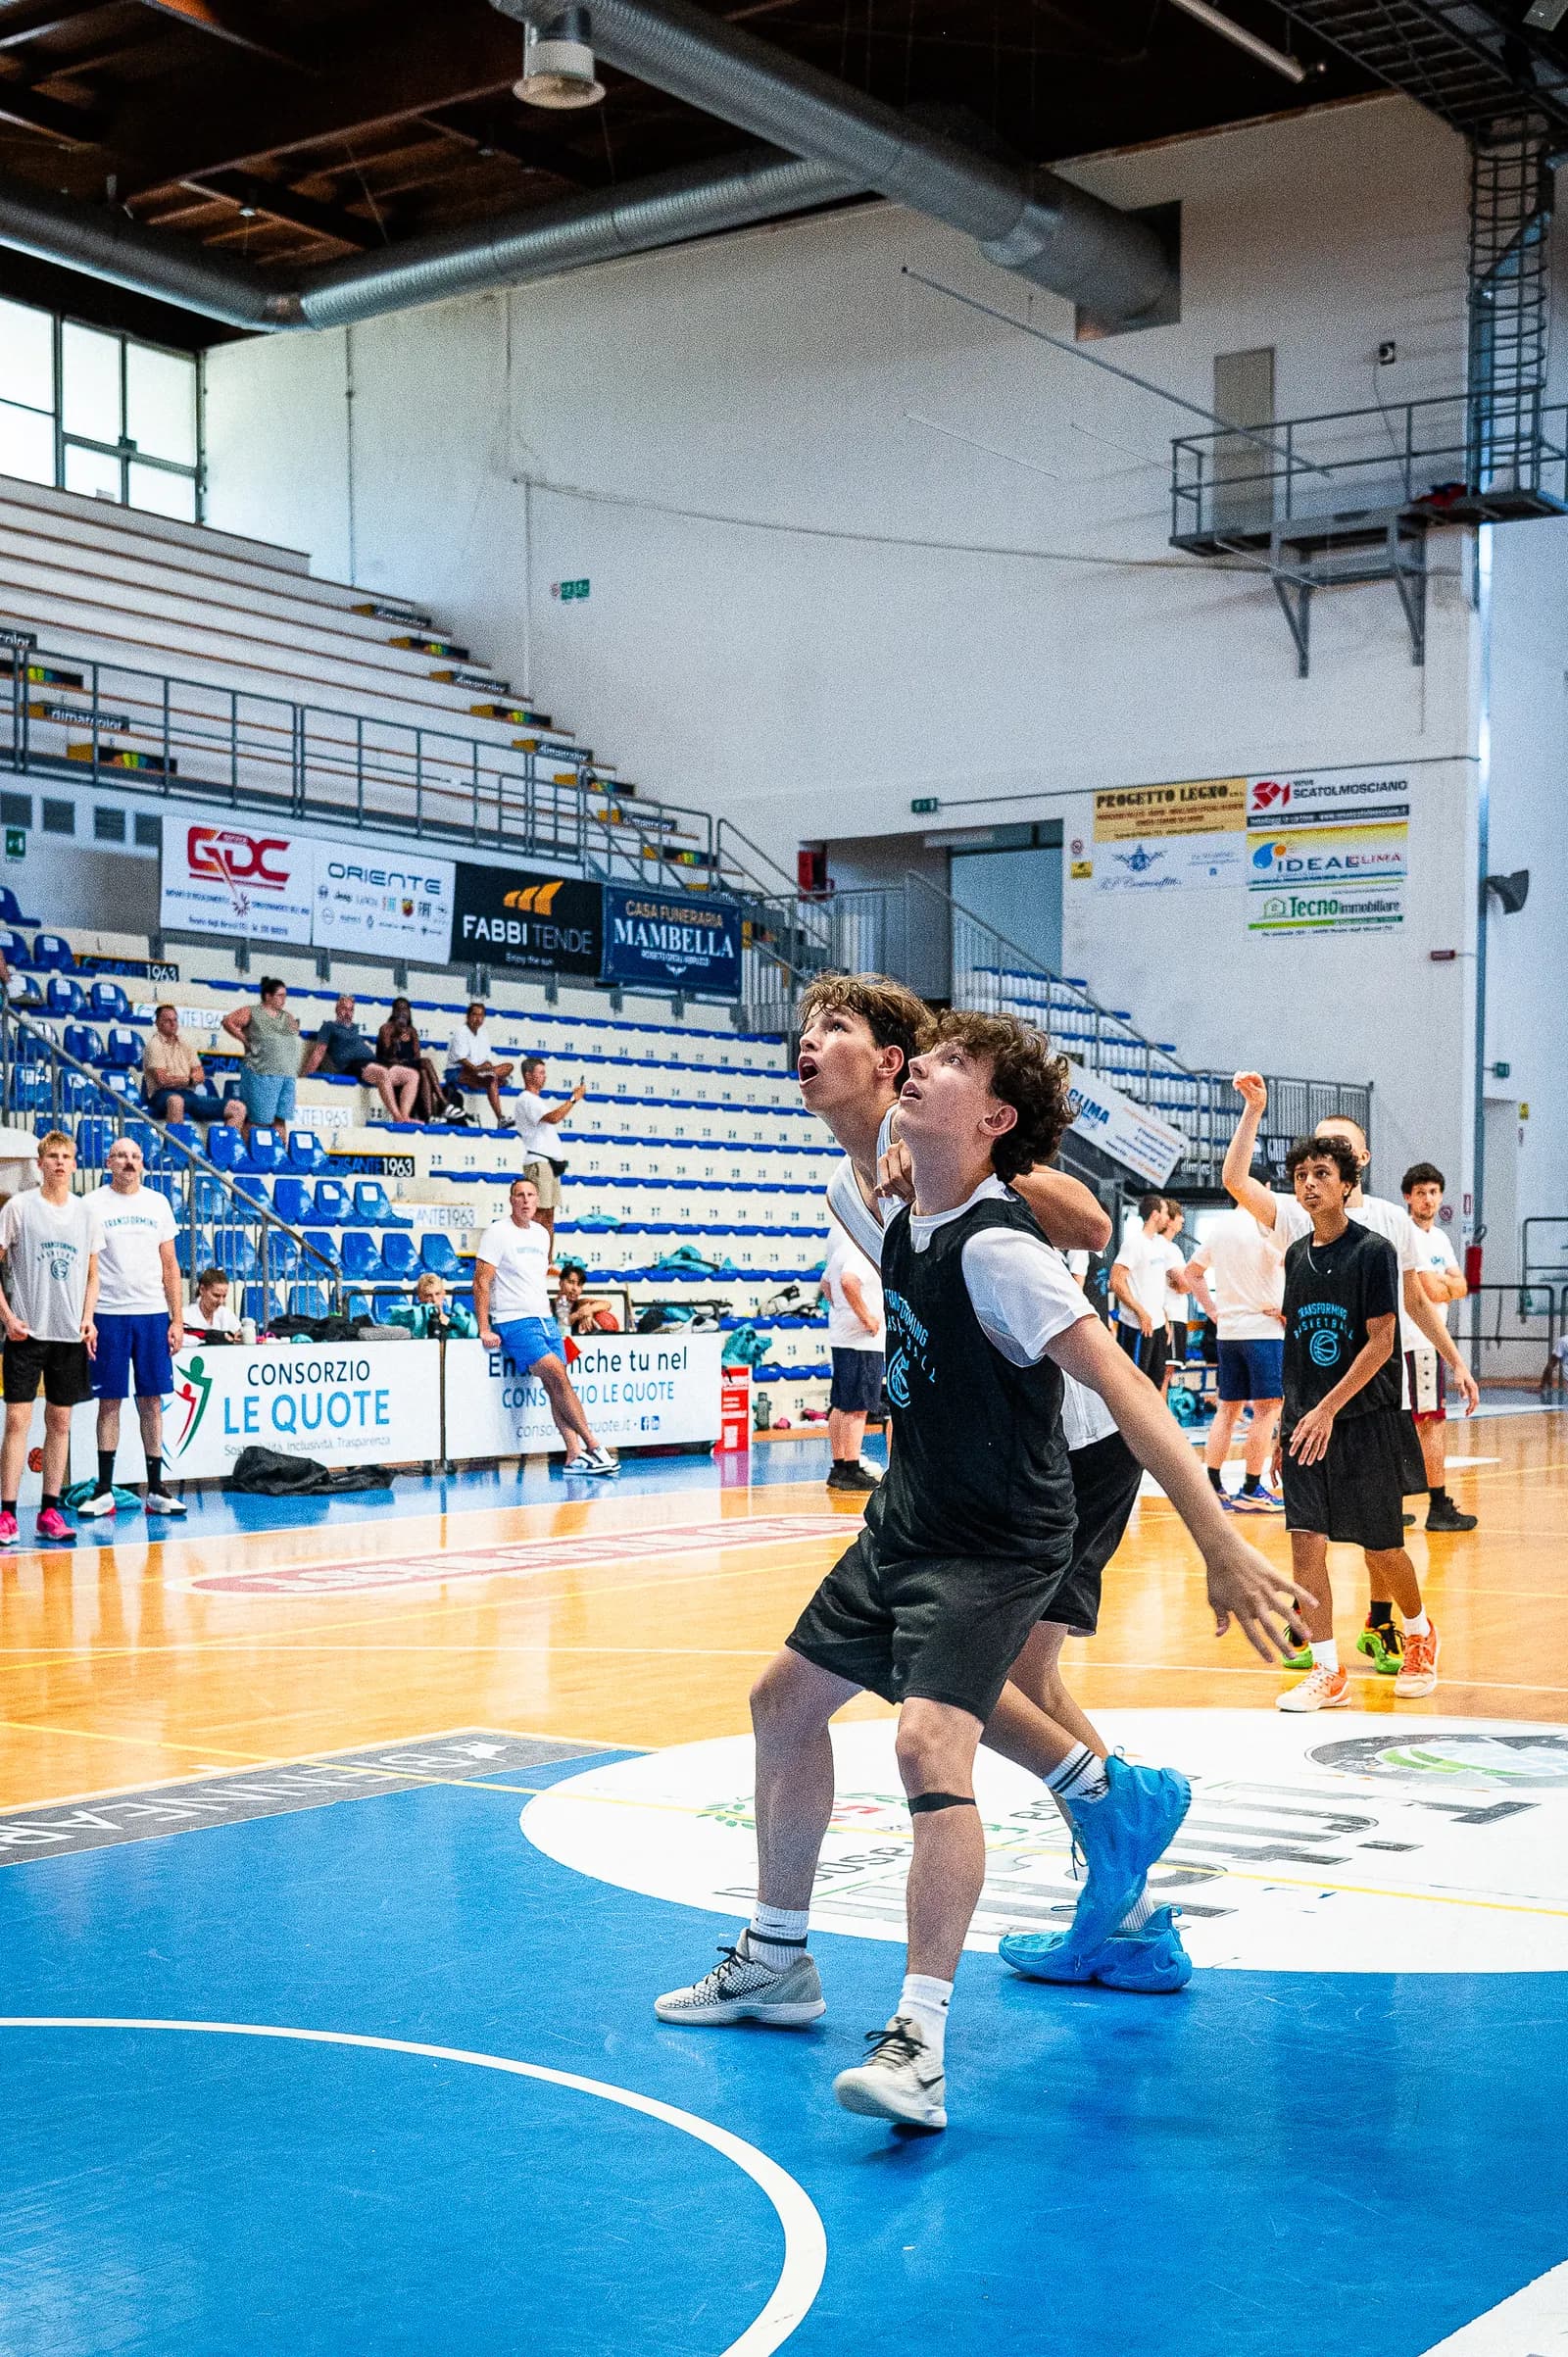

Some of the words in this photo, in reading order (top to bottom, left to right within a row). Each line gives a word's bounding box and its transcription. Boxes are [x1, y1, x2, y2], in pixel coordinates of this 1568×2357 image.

[1097, 789, 1175, 809] PROGETTO
[1180, 785, 1228, 803] LEGNO
[1293, 780, 1408, 800] SCATOLMOSCIANO
[187, 826, 291, 882] GDC
[327, 862, 442, 896] ORIENTE
[625, 900, 658, 921] CASA
[660, 904, 724, 929] FUNERARIA
[463, 914, 527, 946] FABBI
[532, 923, 593, 955] TENDE
[613, 918, 735, 958] MAMBELLA
[146, 964, 177, 981] 1963
[382, 1156, 413, 1177] 1963
[446, 1208, 474, 1229] 1963
[629, 1350, 649, 1371] tu
[658, 1346, 688, 1370] nel
[247, 1360, 370, 1386] CONSORZIO
[603, 1385, 619, 1403] LE
[623, 1381, 674, 1401] QUOTE
[223, 1396, 260, 1435] LE
[271, 1390, 390, 1435] QUOTE
